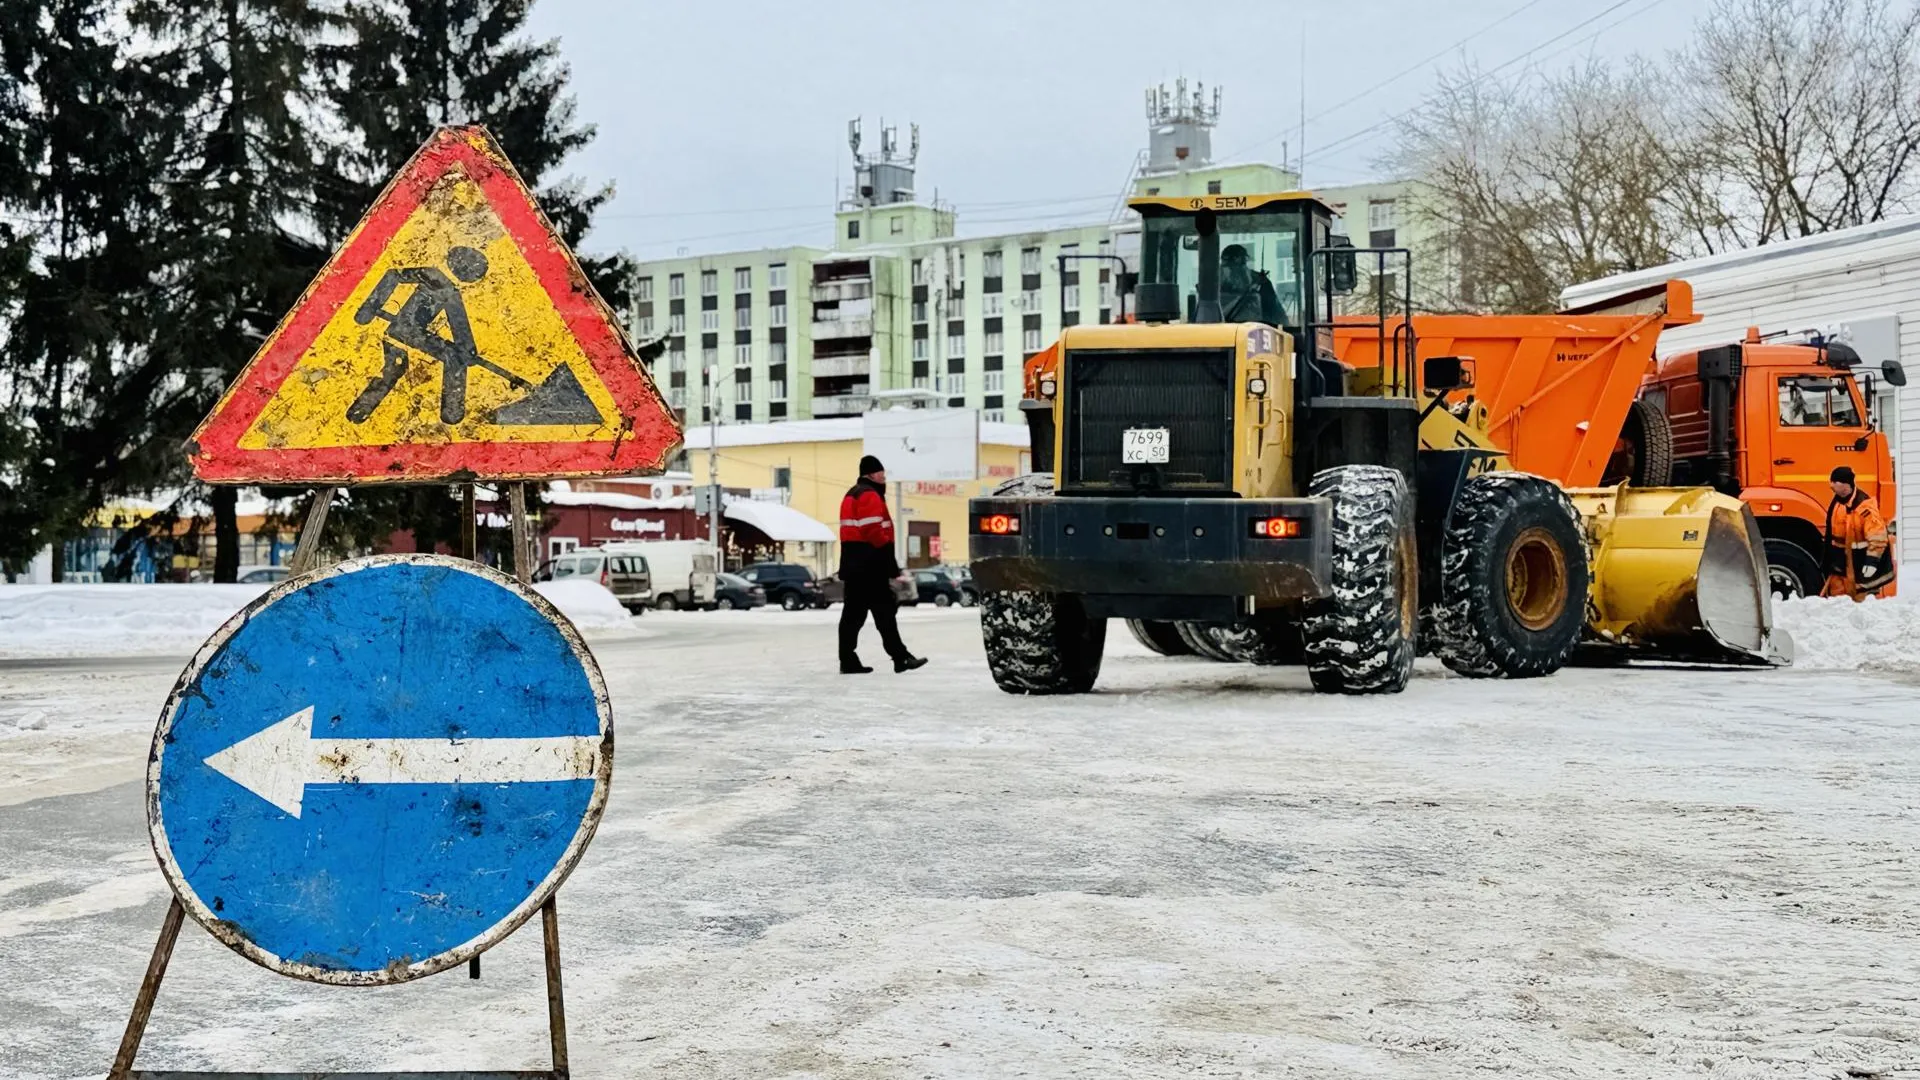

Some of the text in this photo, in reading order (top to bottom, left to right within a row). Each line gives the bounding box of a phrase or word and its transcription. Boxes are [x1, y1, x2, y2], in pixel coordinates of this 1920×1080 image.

[1215, 196, 1247, 208] SEM
[1129, 431, 1163, 444] 7699
[1151, 446, 1166, 457] 50
